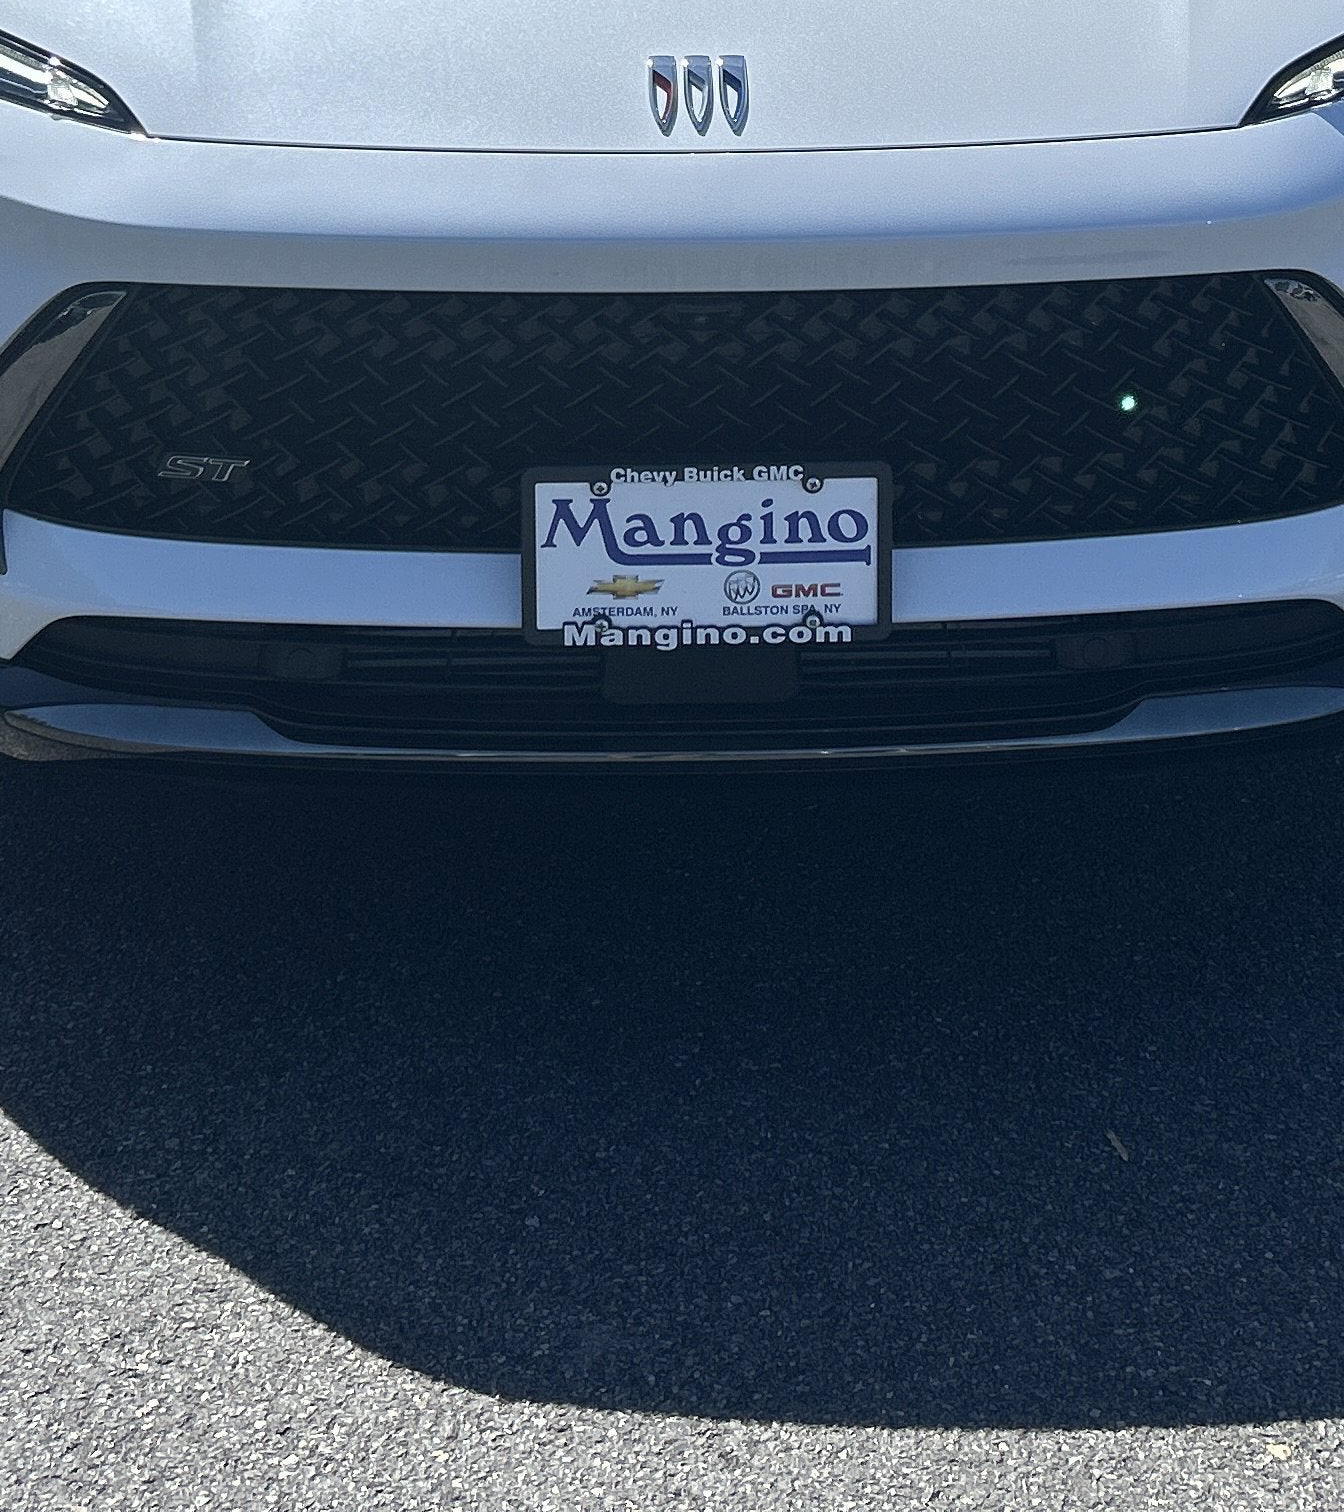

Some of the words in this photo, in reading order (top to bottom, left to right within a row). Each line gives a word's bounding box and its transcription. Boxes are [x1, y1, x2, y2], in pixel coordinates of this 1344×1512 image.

[157, 455, 251, 482] ST
[610, 467, 677, 487] Chevy
[683, 466, 746, 482] Buick
[752, 464, 804, 481] GMC
[541, 497, 871, 567] Mangino
[771, 582, 842, 599] GMC
[660, 606, 679, 617] NY
[722, 605, 789, 617] BALLSTON
[823, 603, 842, 614] NY
[562, 619, 853, 651] Mangino.com
